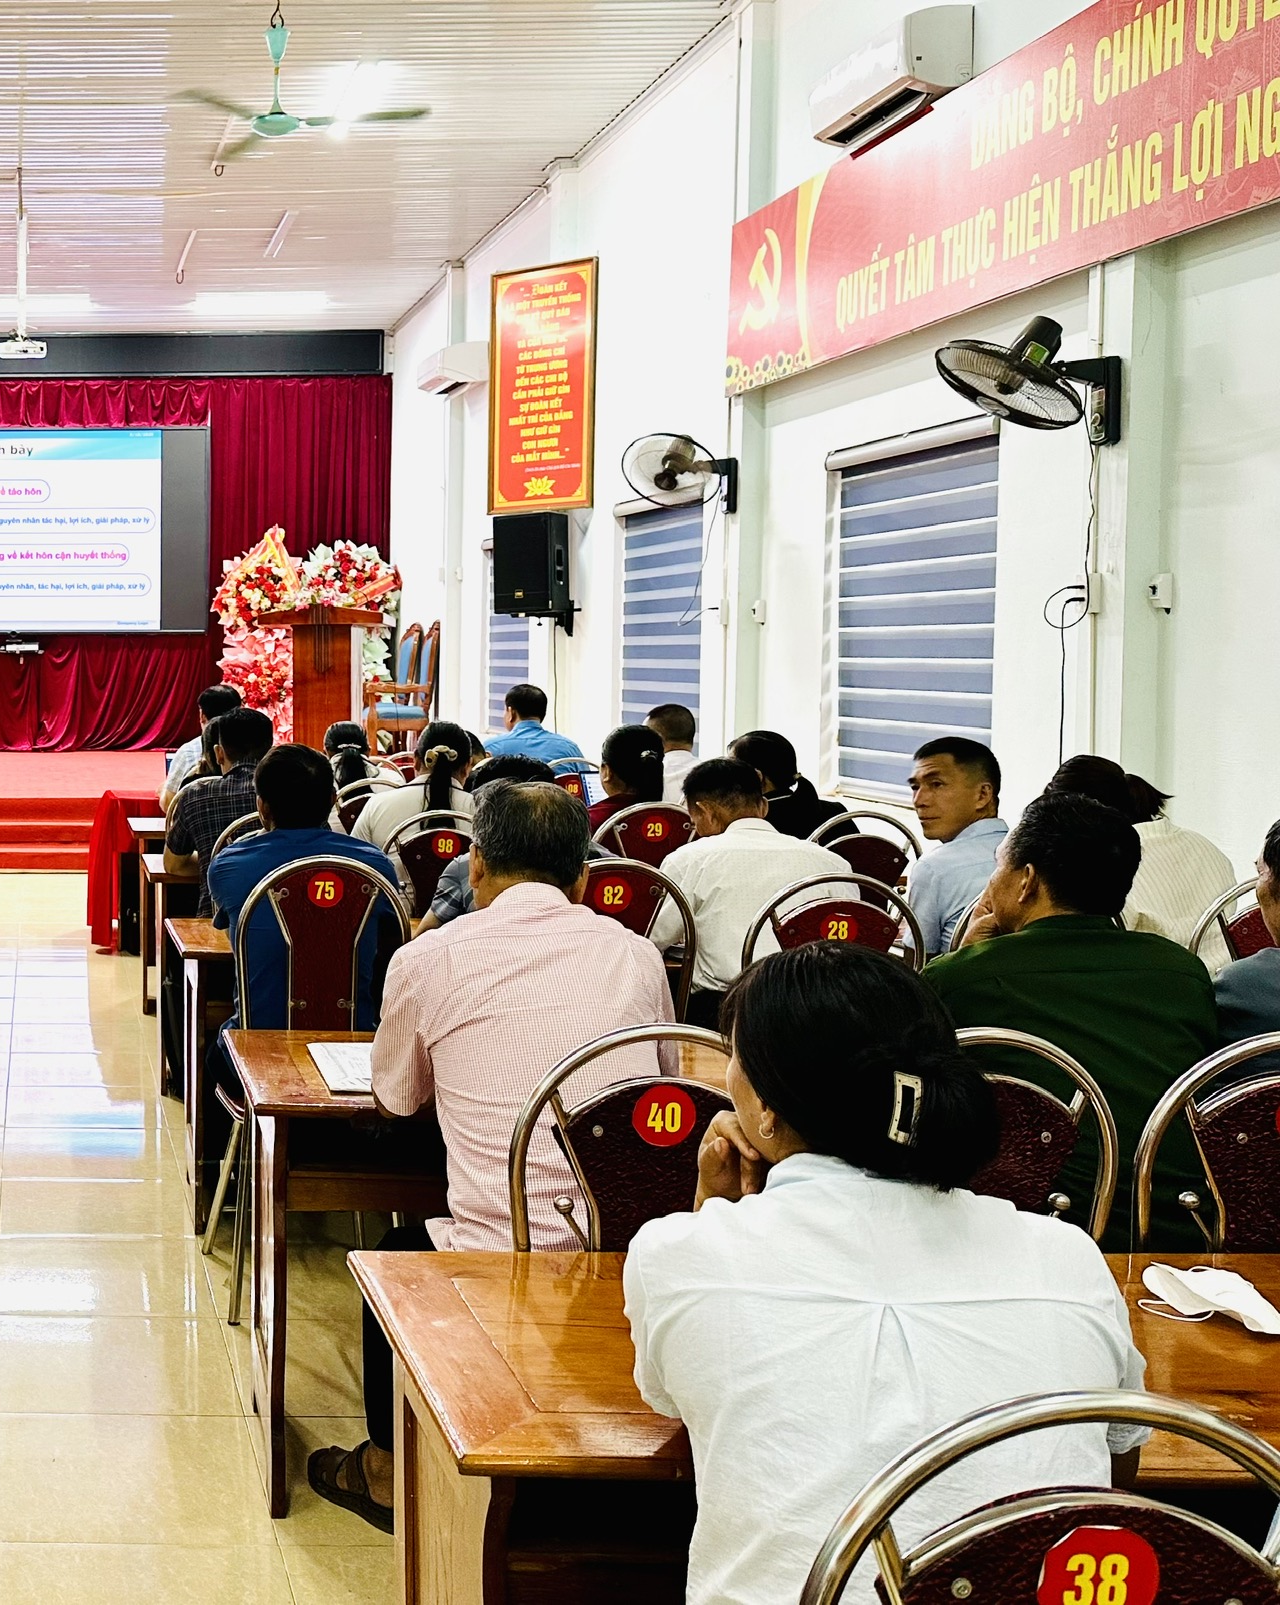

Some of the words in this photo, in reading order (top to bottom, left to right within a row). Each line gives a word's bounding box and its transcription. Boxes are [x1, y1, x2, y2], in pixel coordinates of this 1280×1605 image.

[1042, 44, 1083, 138] BỘ,
[1093, 0, 1185, 105] CHÍNH
[835, 243, 890, 334] QUYẾT
[894, 233, 936, 305] TÂM
[941, 206, 997, 289] THỰC
[1002, 172, 1061, 265] HIỆN
[1069, 123, 1163, 234] THẮNG
[1172, 98, 1224, 202] LỢI
[24, 488, 42, 496] hôn
[70, 517, 78, 526] lợi
[36, 552, 52, 560] hôn
[74, 550, 98, 561] huyết
[100, 550, 126, 560] thống
[646, 822, 663, 837] 29
[438, 838, 453, 853] 98
[315, 881, 335, 900] 75
[603, 885, 624, 905] 82
[827, 920, 849, 940] 28
[647, 1101, 682, 1133] 40
[1063, 1552, 1131, 1605] 38
